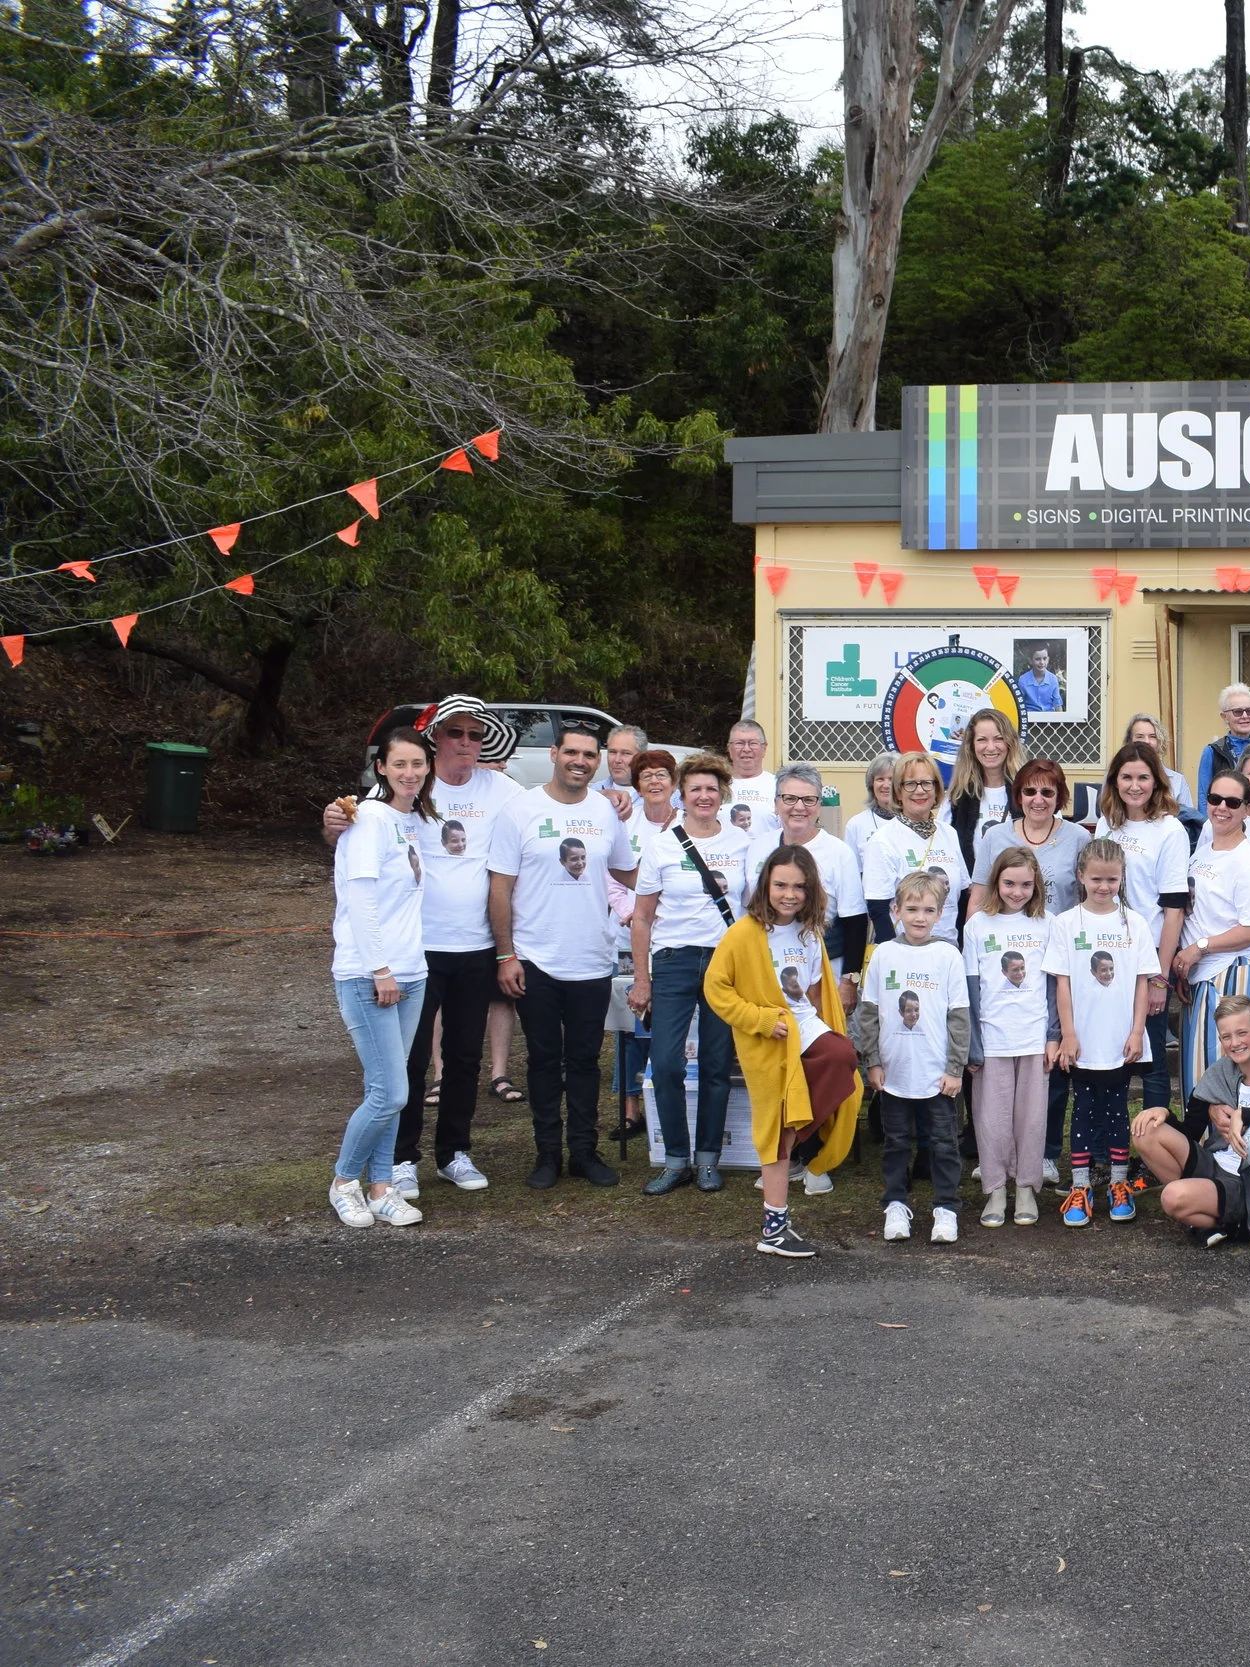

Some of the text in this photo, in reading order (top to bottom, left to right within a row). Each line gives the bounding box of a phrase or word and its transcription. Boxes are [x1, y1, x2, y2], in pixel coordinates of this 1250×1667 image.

[1026, 508, 1081, 524] SIGNS
[1101, 508, 1167, 524] DIGITAL
[448, 803, 474, 811] LEVI'S
[448, 810, 486, 818] PROJECT
[566, 820, 593, 828] LEVI'S
[567, 827, 604, 836] PROJECT
[706, 853, 730, 861] LEVI'S
[1007, 934, 1032, 942] LEVI'S
[1097, 933, 1122, 941] LEVI'S
[906, 973, 930, 981] LEVI'S
[906, 980, 939, 990] PROJECT
